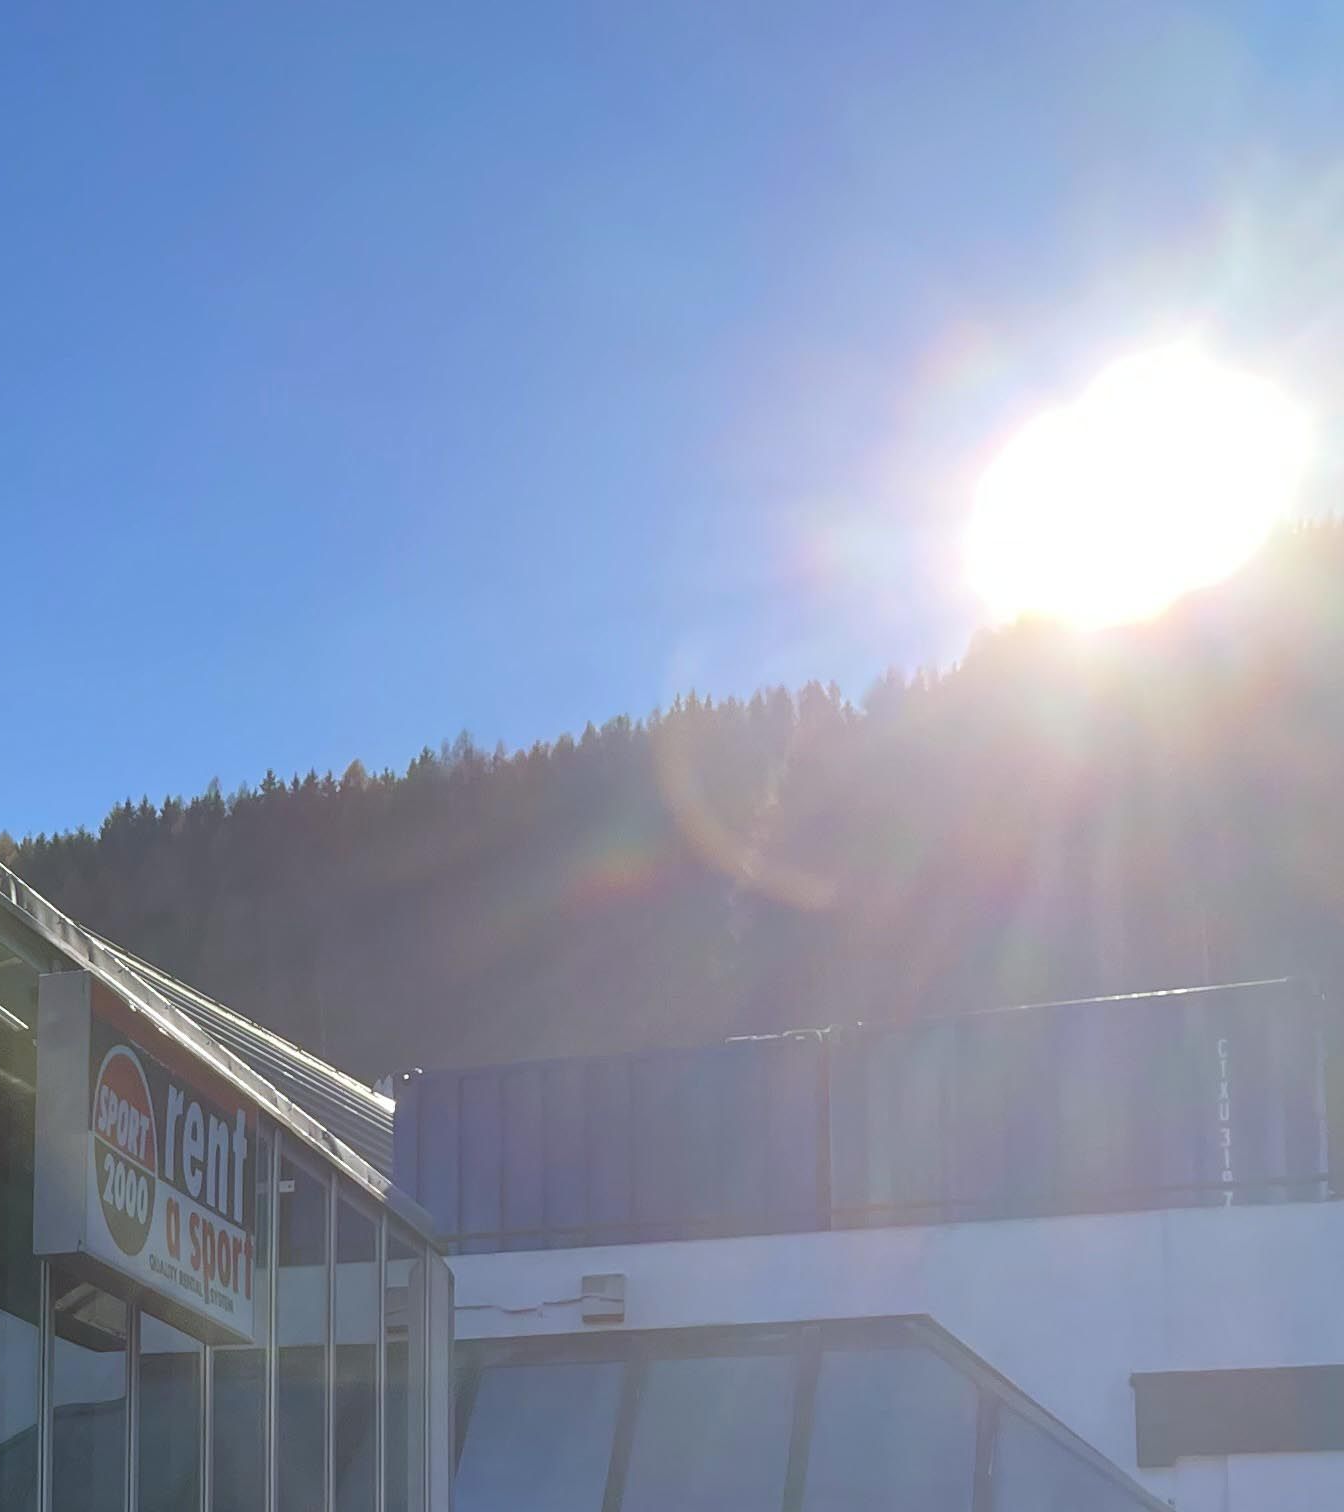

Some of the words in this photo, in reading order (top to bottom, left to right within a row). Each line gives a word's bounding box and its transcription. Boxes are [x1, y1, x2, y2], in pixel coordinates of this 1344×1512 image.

[97, 1083, 151, 1162] SPORT
[164, 1083, 248, 1224] rent
[102, 1152, 149, 1225] 2000
[166, 1196, 181, 1262] a
[188, 1212, 255, 1304] sport
